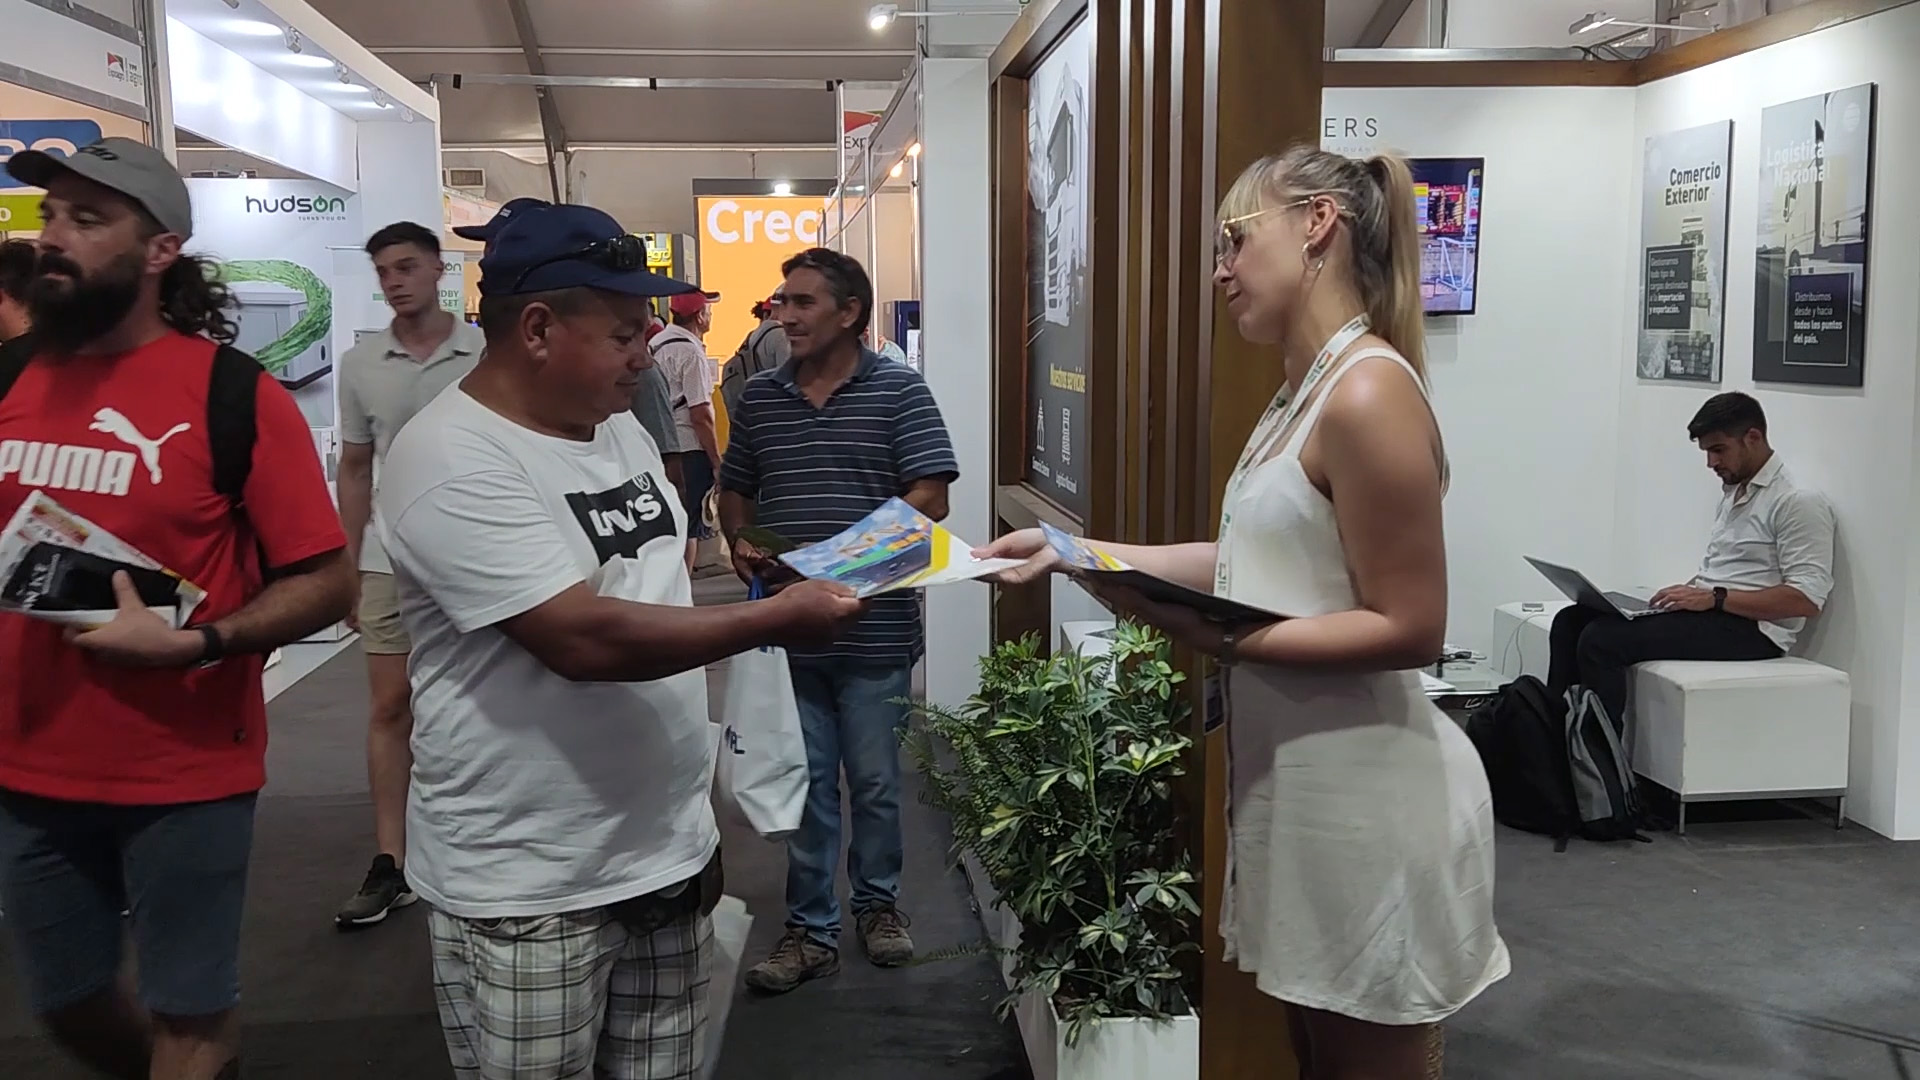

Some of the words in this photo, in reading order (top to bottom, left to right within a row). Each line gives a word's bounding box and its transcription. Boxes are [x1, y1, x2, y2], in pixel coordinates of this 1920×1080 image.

[1670, 161, 1721, 186] Comercio
[245, 194, 345, 213] hudson
[1665, 184, 1710, 206] Exterior
[1793, 320, 1811, 329] todos
[1811, 320, 1821, 329] los
[1821, 320, 1843, 331] puntos
[1793, 333, 1804, 343] del
[0, 440, 137, 496] PUMA
